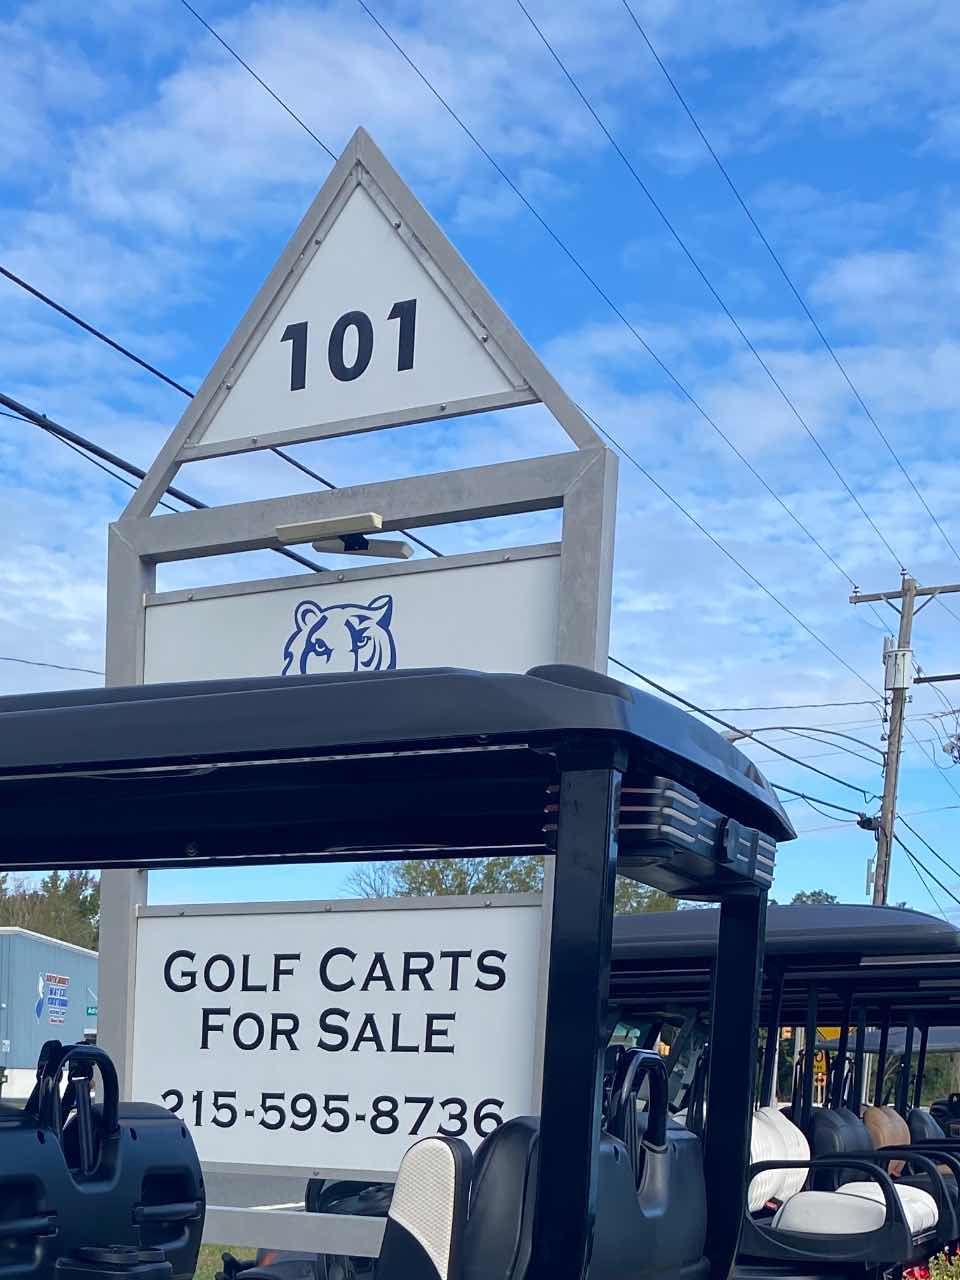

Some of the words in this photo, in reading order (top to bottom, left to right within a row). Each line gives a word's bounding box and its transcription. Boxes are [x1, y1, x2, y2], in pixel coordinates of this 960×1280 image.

[280, 298, 417, 392] 101
[163, 948, 301, 993] GOLF
[318, 946, 508, 992] CARTS
[199, 1007, 300, 1051] FOR
[316, 1006, 457, 1054] SALE
[160, 1088, 506, 1138] 215-595-8736
